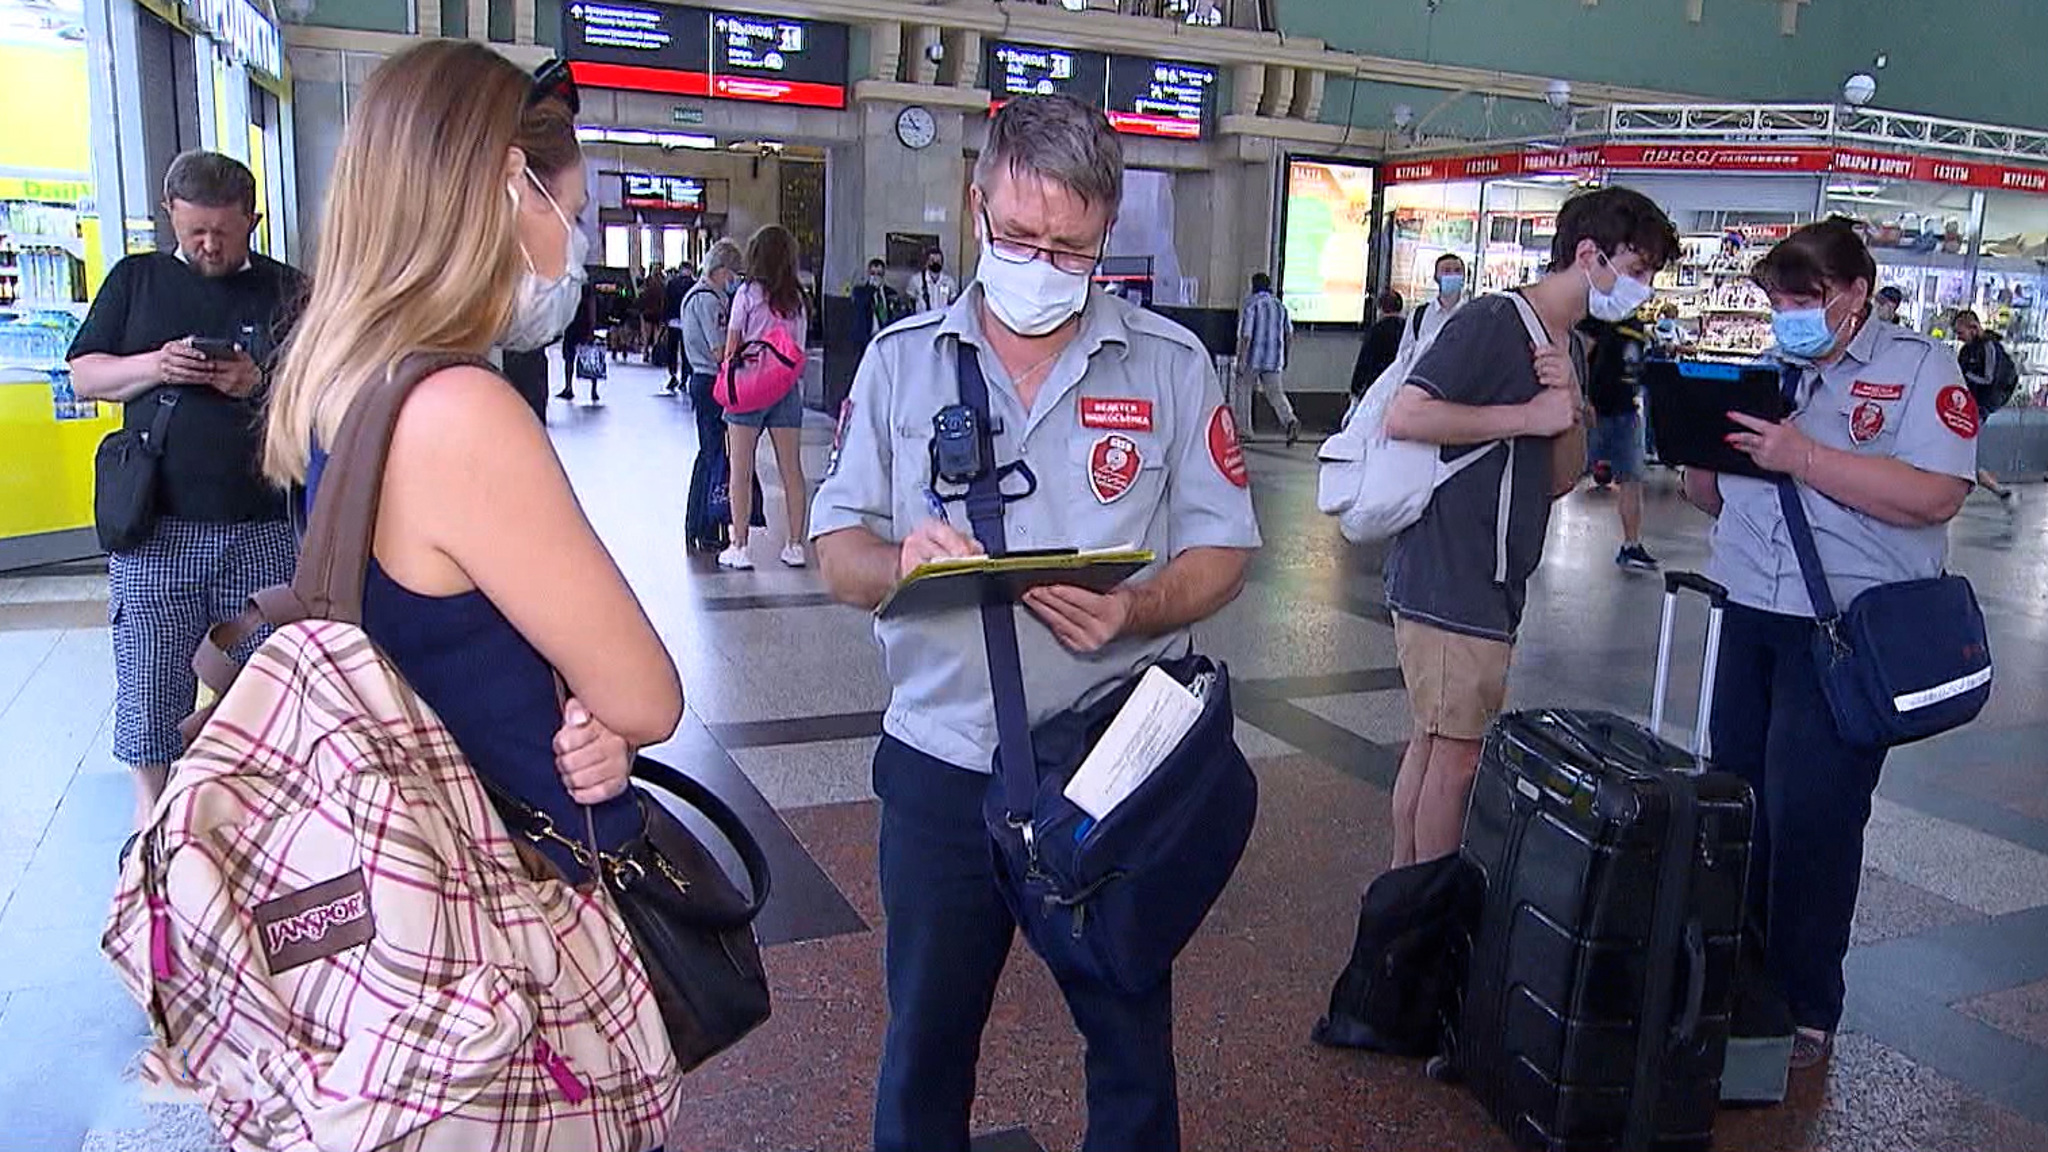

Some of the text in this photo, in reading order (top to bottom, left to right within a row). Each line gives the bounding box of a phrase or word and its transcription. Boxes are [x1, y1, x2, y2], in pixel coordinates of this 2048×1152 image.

[1466, 158, 1499, 174] ГАЗЕТЫ
[1835, 153, 1870, 171] ТОВАРЫ
[1933, 163, 1969, 181] ГАЗЕТЫ
[2002, 171, 2046, 190] ЖУРНАЛЫ
[265, 890, 367, 955] JANSPOR
